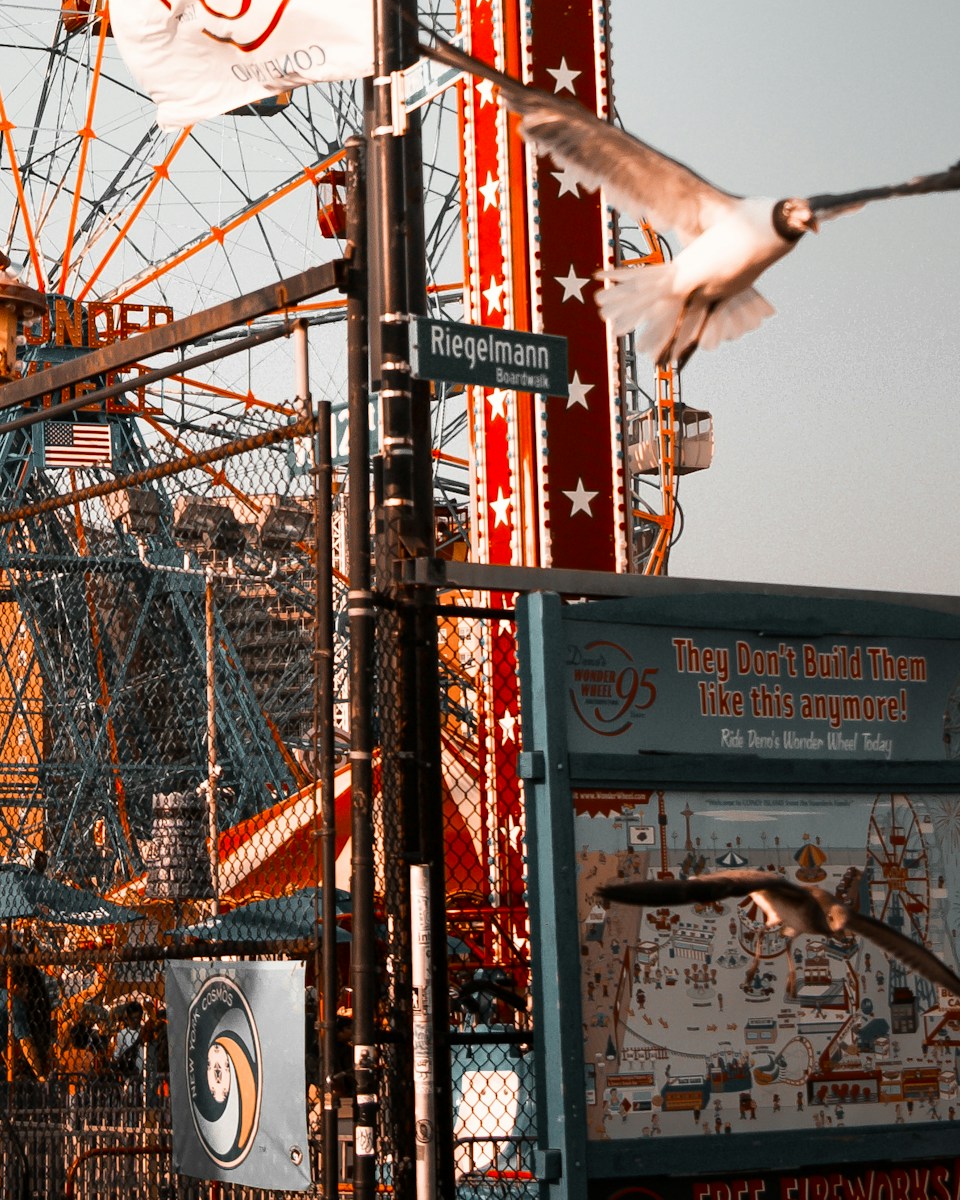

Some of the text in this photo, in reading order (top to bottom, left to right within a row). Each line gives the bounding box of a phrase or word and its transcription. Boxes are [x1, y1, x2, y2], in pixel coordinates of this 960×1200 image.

[430, 325, 549, 370] Riegelmann
[496, 368, 550, 389] Boardwalk
[573, 668, 616, 683] WONDER
[672, 637, 927, 684] They Don't Build Them
[581, 683, 612, 698] WHEEL
[594, 666, 659, 723] 95
[697, 681, 908, 729] like this anymore!
[721, 728, 892, 760] Ride Deno's Wonder Wheel Today
[188, 989, 234, 1099] NEW YORK COSMOS
